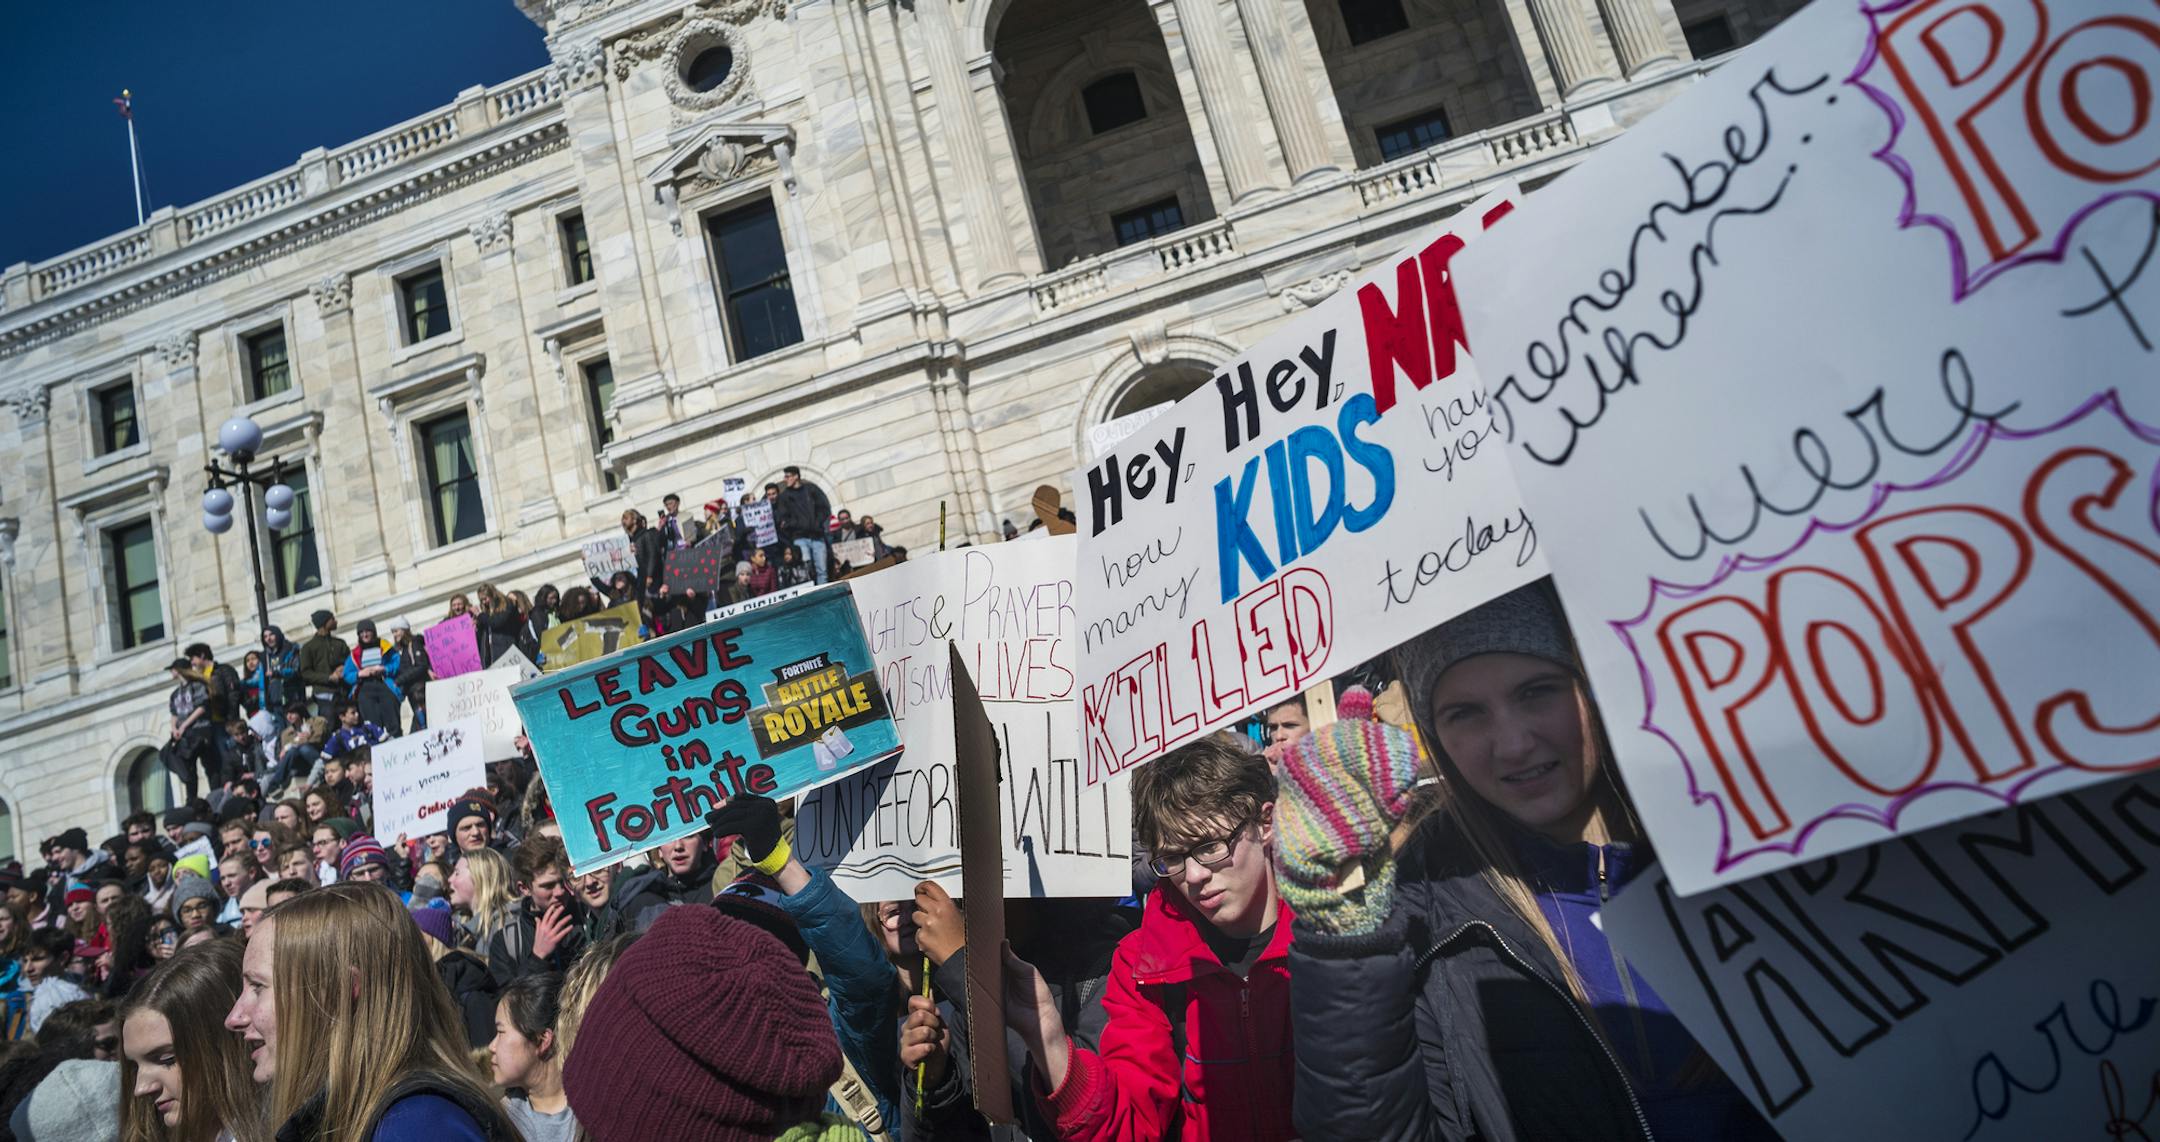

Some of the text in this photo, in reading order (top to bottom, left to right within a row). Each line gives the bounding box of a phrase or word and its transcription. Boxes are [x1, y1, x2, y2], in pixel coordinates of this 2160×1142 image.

[1215, 200, 1515, 453] Hey, NR
[1523, 165, 1797, 466] when
[1421, 387, 1486, 439] hav
[1637, 348, 2021, 561] were
[1087, 392, 1395, 605] Hey, KIDS
[869, 595, 928, 654] GHTS
[962, 550, 1076, 640] PRAYER
[1101, 526, 1182, 588] how
[1083, 507, 1538, 786] KILLED today
[1084, 567, 1200, 654] many
[1655, 446, 2160, 841] POPS
[559, 628, 753, 721] LEAVE
[610, 679, 752, 748] Guns
[763, 681, 873, 744] ROYALE
[778, 669, 840, 706] BATTLE
[781, 656, 824, 680] FORTNITE
[978, 638, 1075, 701] LIVES
[585, 750, 779, 853] Fortnite
[660, 739, 713, 772] in
[861, 762, 962, 850] REFOR
[1002, 710, 1129, 860] WILL
[418, 798, 455, 819] CHANG
[1962, 978, 2159, 1142] are
